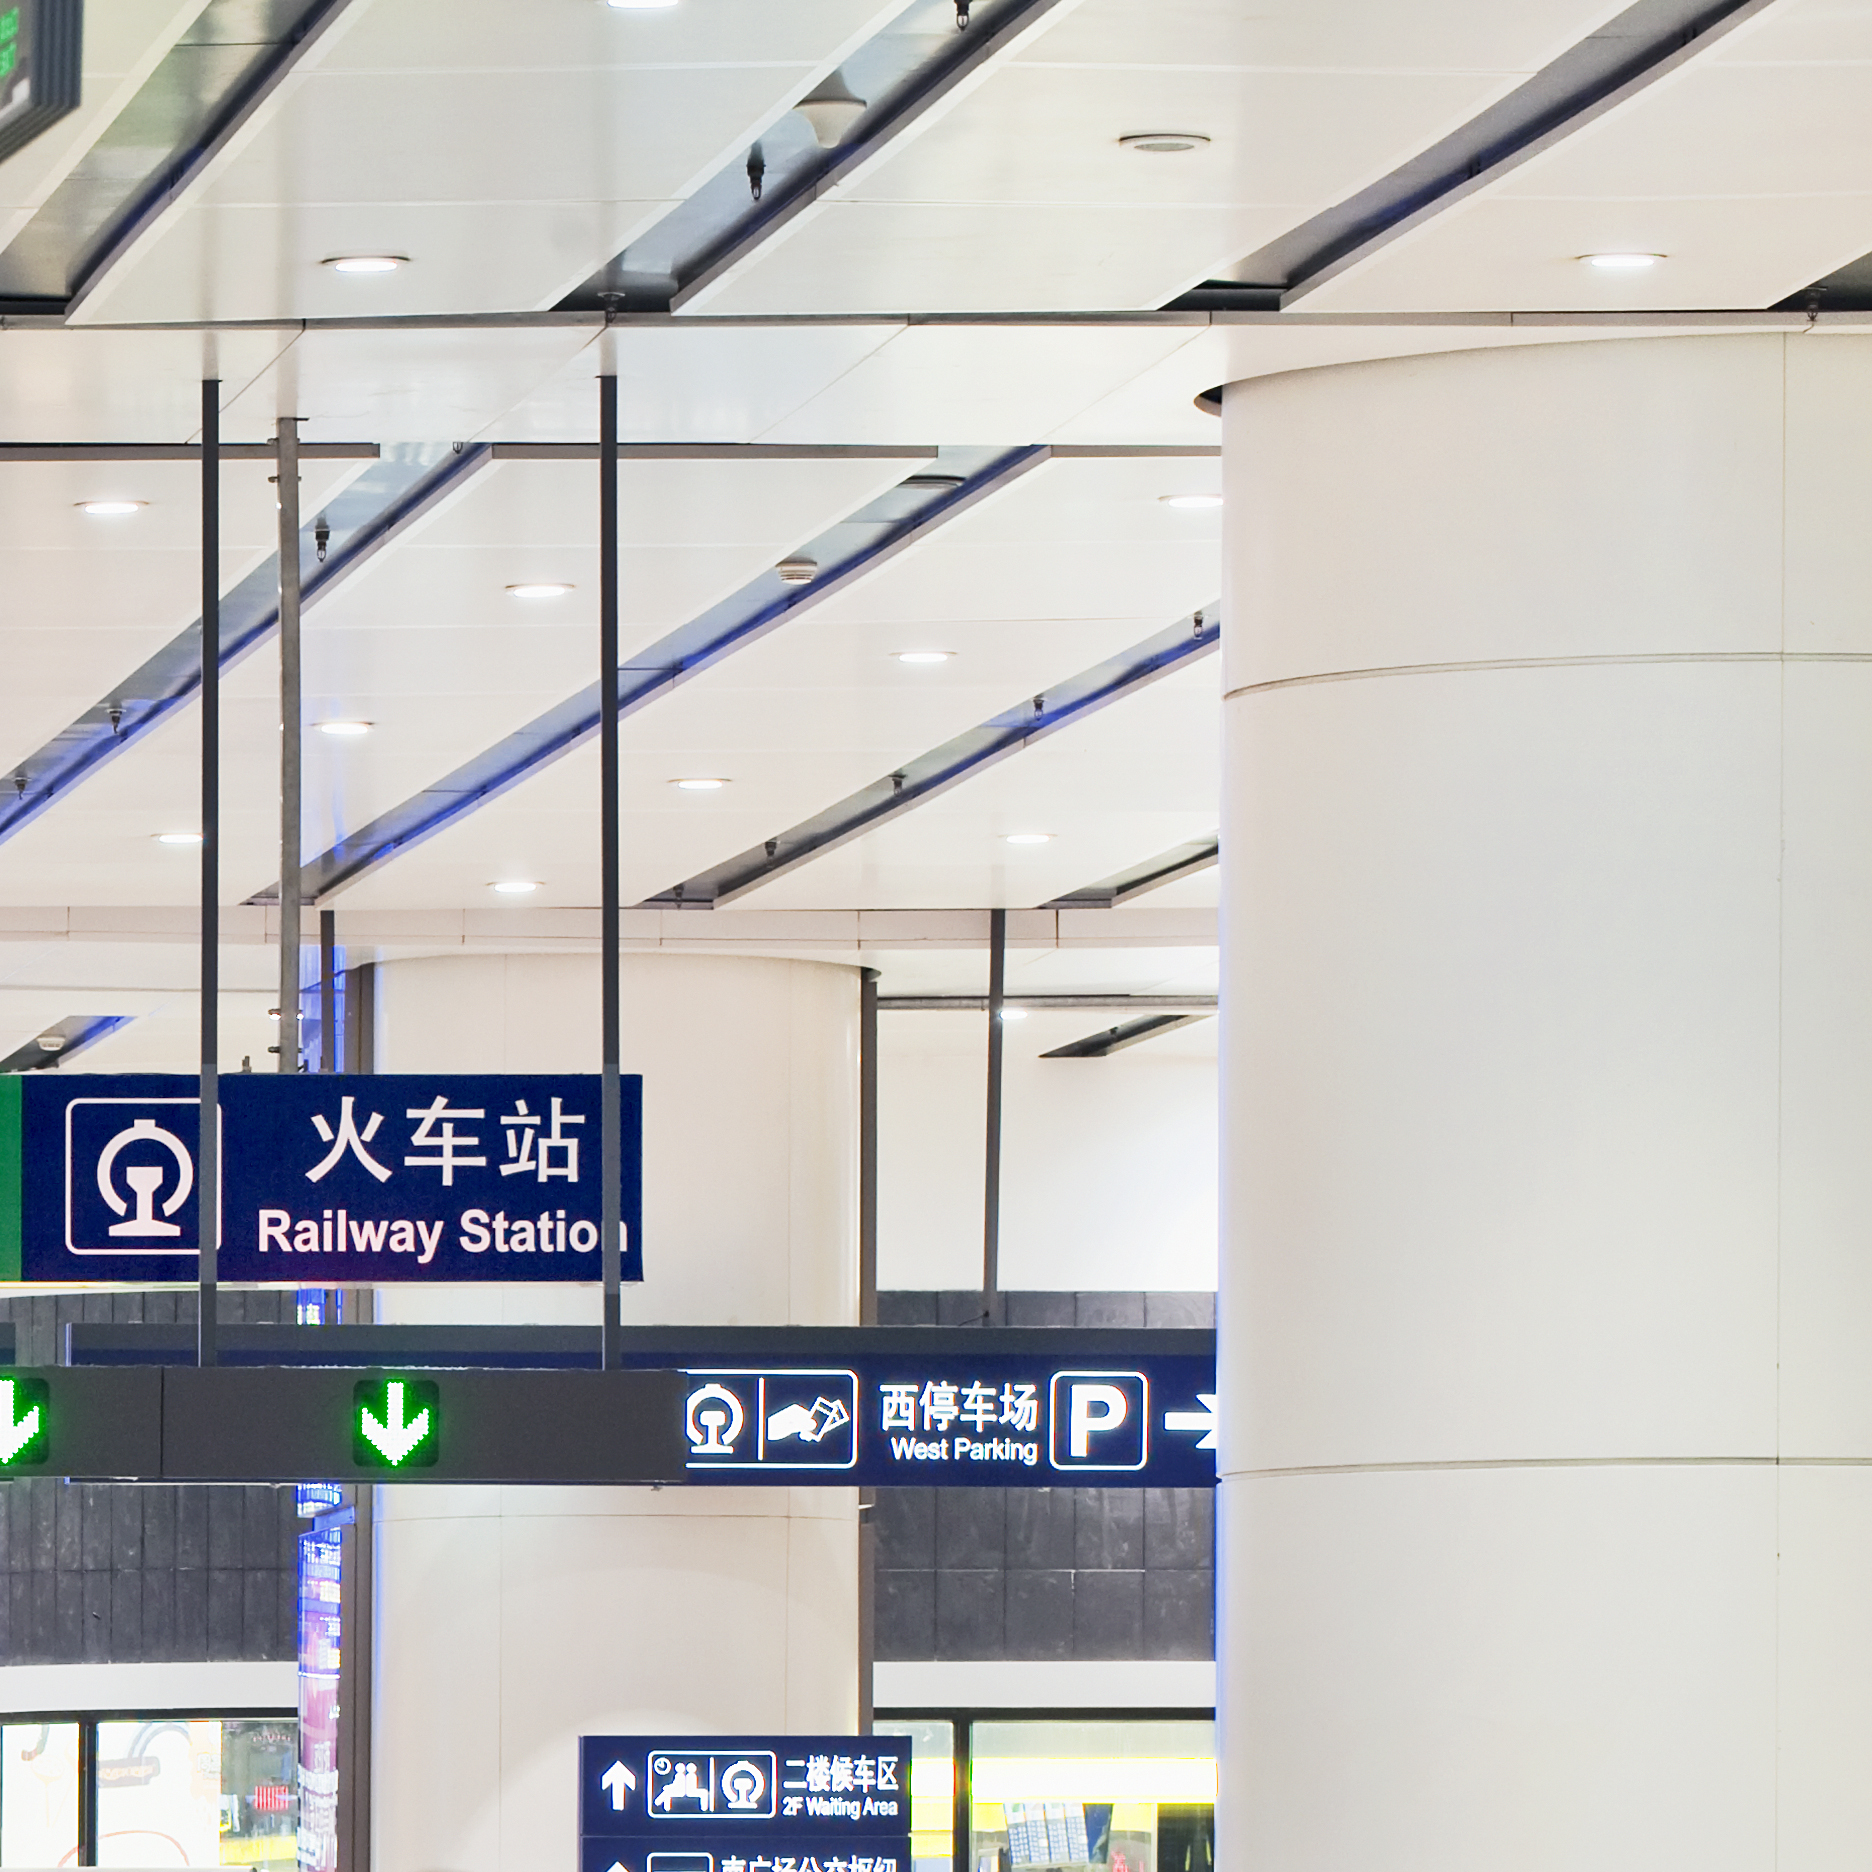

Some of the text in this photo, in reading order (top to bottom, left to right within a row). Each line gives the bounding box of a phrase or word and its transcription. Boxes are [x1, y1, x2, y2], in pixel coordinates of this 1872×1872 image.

[305, 1096, 585, 1186] 火车站
[258, 1208, 444, 1267] Railway
[880, 1381, 1037, 1432] 西停车场
[891, 1437, 1038, 1465] West Parking
[784, 1755, 899, 1793] 二楼候车区
[783, 1796, 898, 1820] 2F Waiting Area
